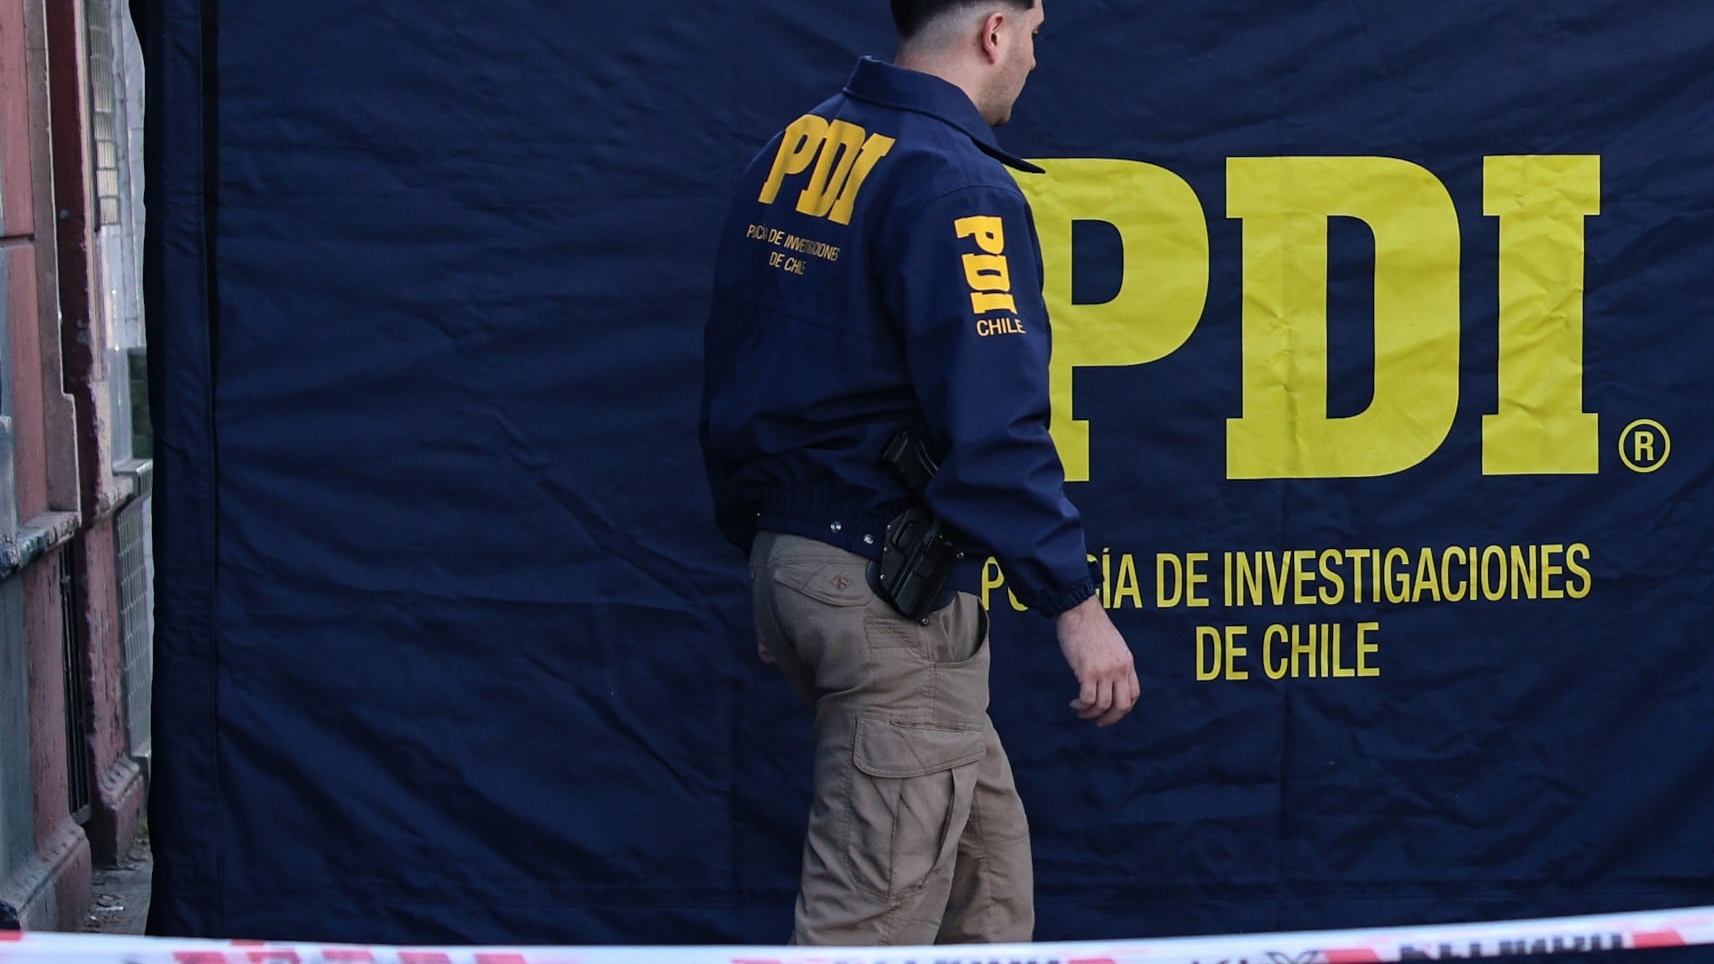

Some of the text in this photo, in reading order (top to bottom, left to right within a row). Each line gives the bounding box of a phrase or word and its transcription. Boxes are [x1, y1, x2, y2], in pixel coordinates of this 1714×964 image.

[758, 114, 896, 225] PDI
[768, 228, 785, 246] DE
[769, 251, 786, 268] DE
[954, 215, 1018, 315] PDI
[975, 318, 1026, 337] CHILE
[1004, 154, 1601, 482] PDI
[1156, 552, 1210, 609] DE
[1223, 542, 1592, 607] INVESTIGACIONES
[1195, 621, 1381, 681] DE CHILE
